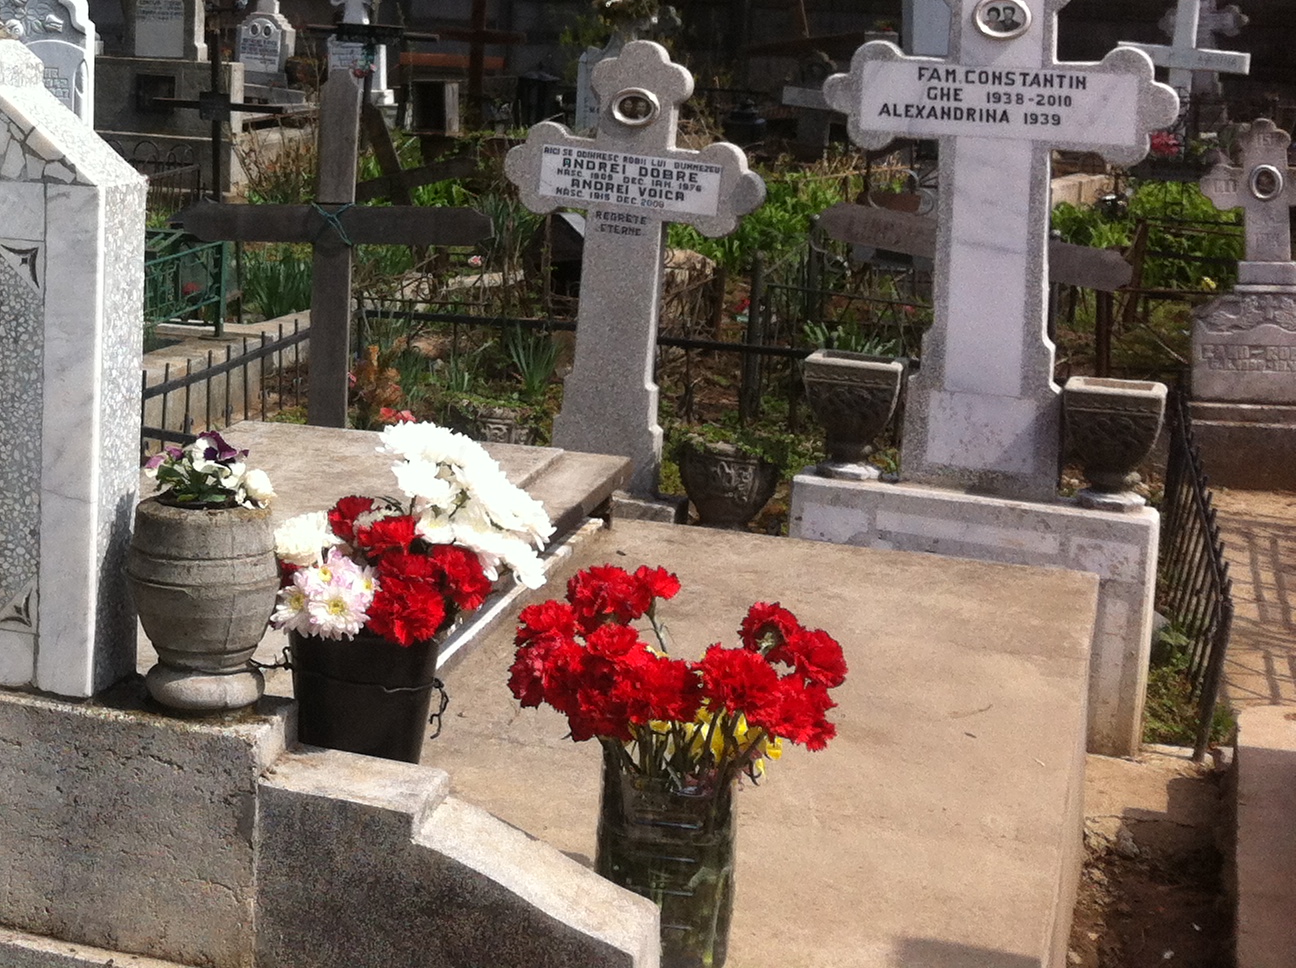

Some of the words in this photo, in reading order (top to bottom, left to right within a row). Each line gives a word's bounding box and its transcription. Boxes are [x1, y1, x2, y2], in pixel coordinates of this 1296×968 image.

[964, 70, 1088, 90] CONSTANTIN
[927, 86, 963, 102] GHE
[878, 103, 1011, 124] ALEXANDRINA
[1023, 113, 1062, 126] 1939
[562, 148, 573, 157] SE
[651, 159, 666, 168] LUI
[563, 158, 626, 175] ANDREI
[639, 166, 698, 183] DOBRE
[571, 178, 629, 195] ANDREI
[638, 186, 685, 201] VOICA
[595, 211, 647, 225] REGRETE
